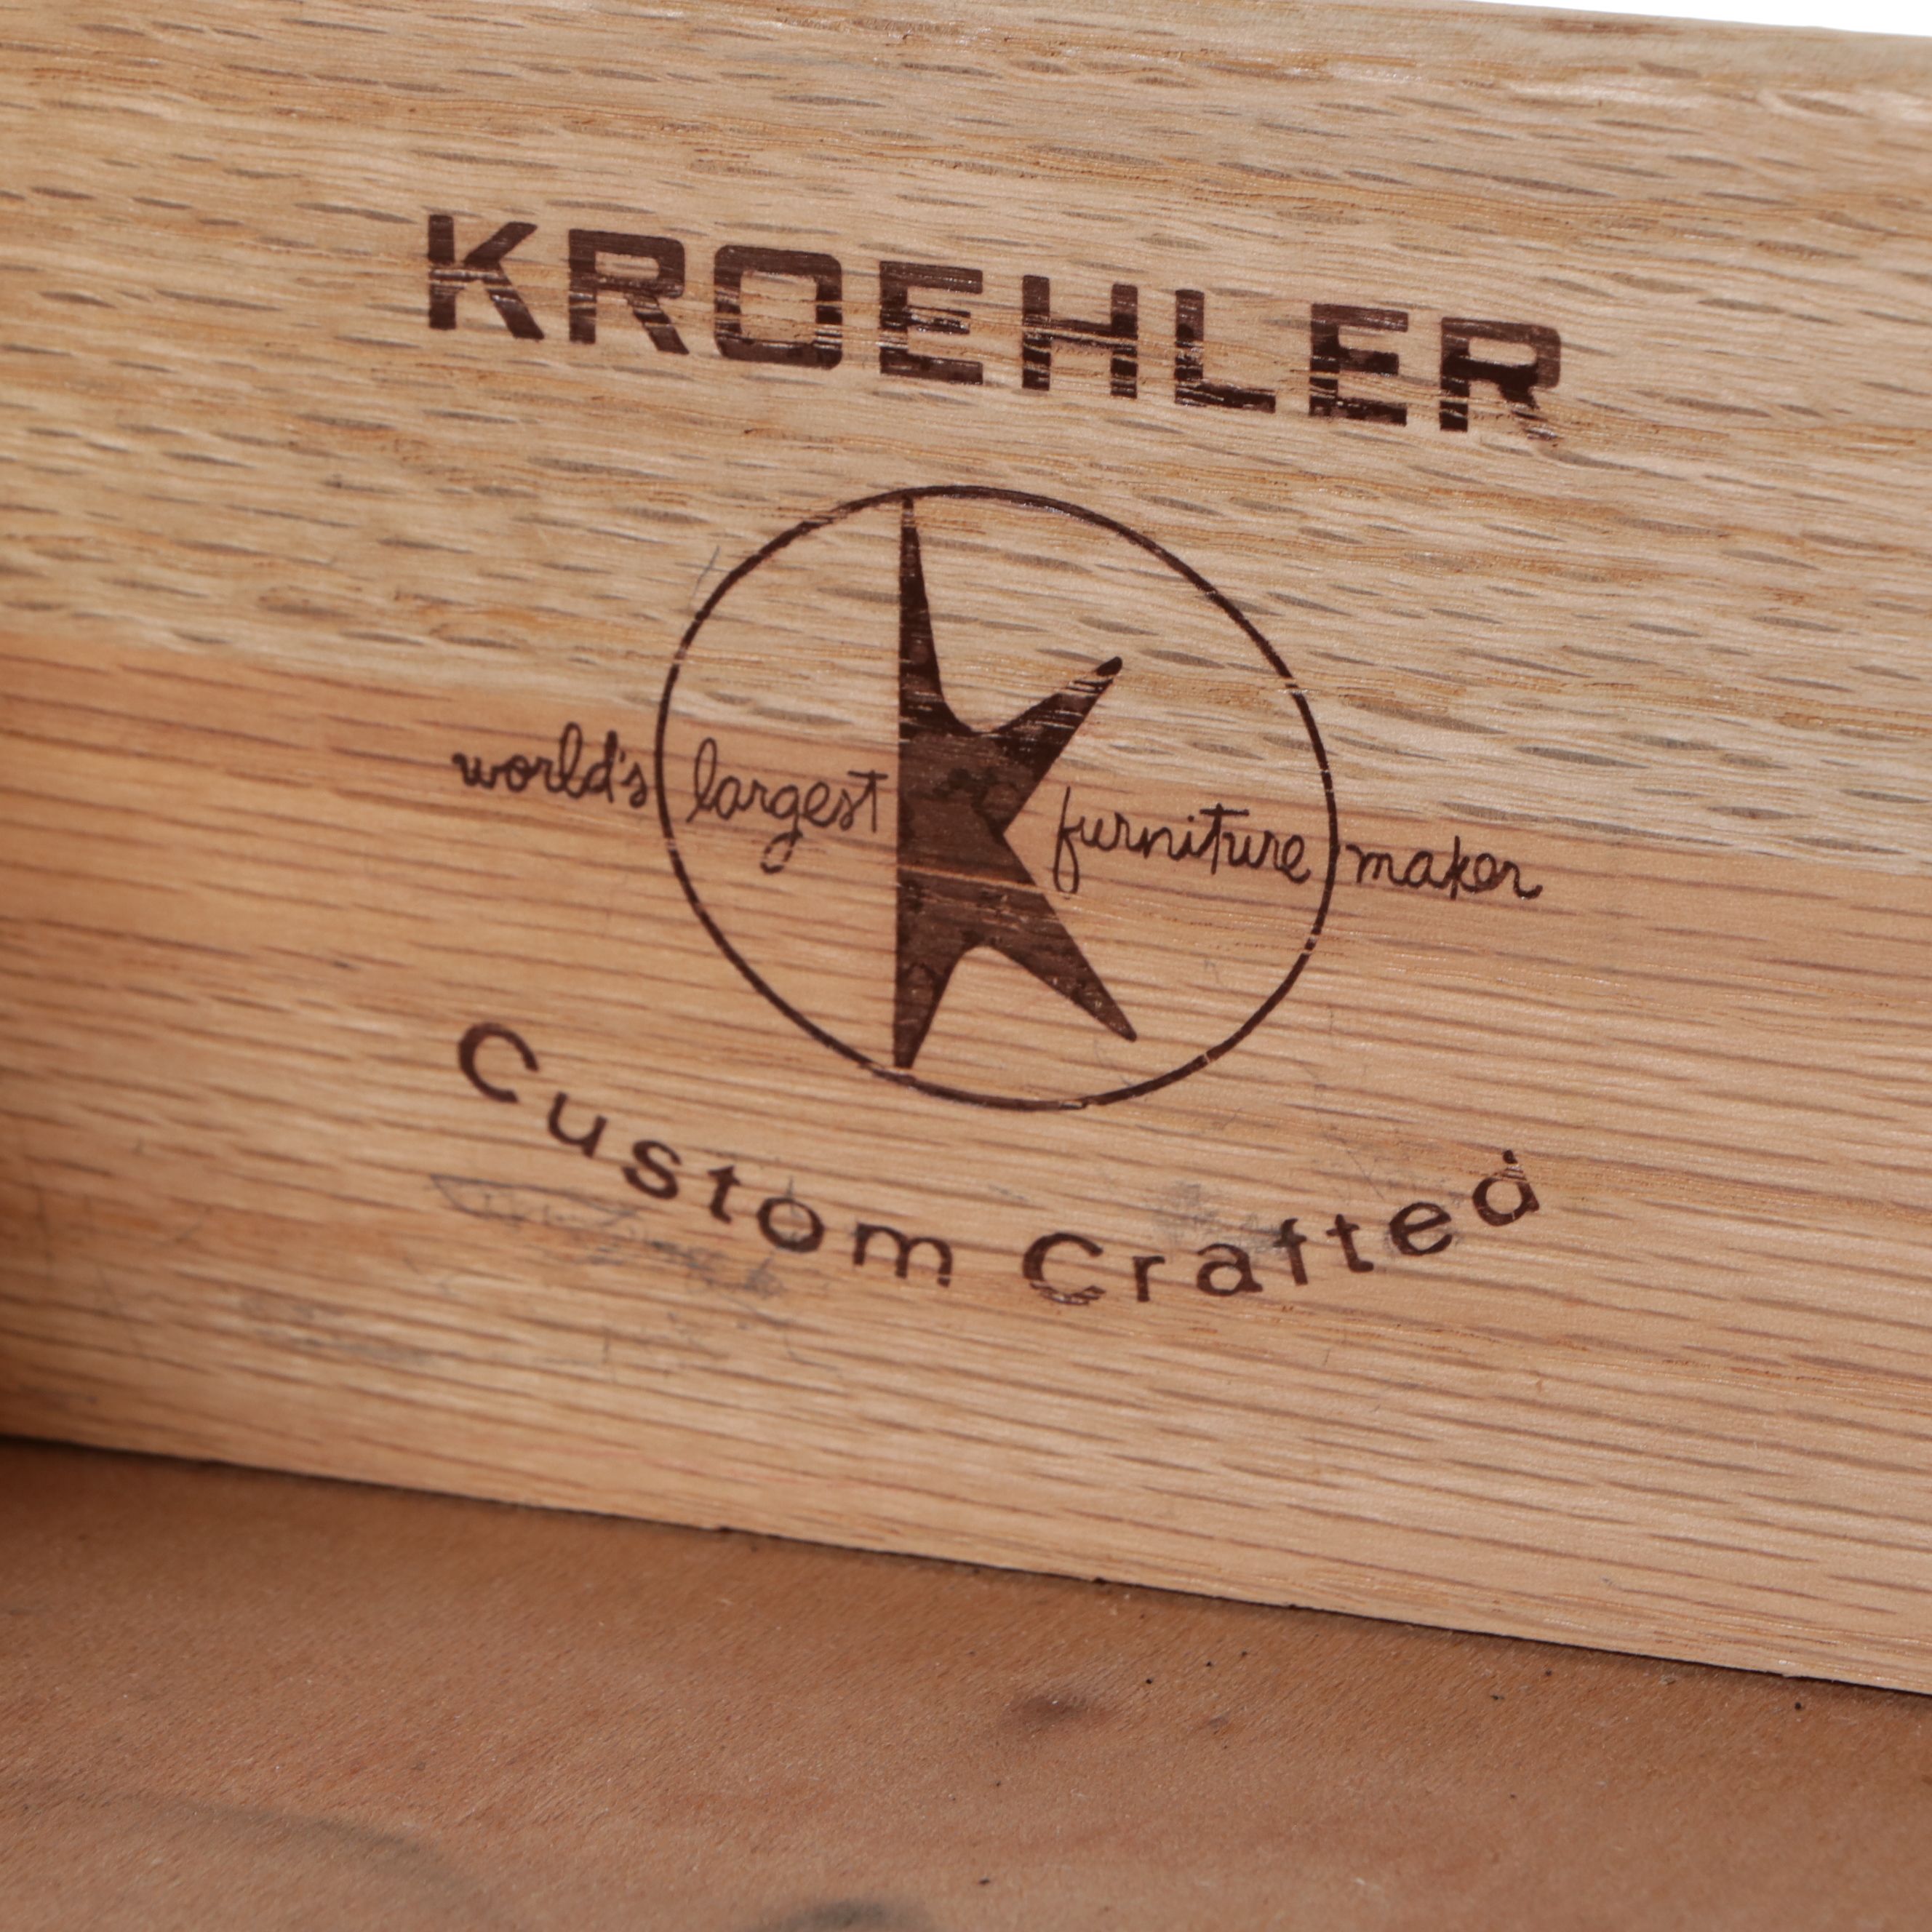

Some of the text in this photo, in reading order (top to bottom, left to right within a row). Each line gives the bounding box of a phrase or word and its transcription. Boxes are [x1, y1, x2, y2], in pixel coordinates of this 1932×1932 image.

[427, 214, 1561, 441] KROEHLER
[451, 722, 1544, 901] world's largest furniture maker
[893, 495, 1136, 1069] K
[457, 1021, 1541, 1306] Custom Crafted
